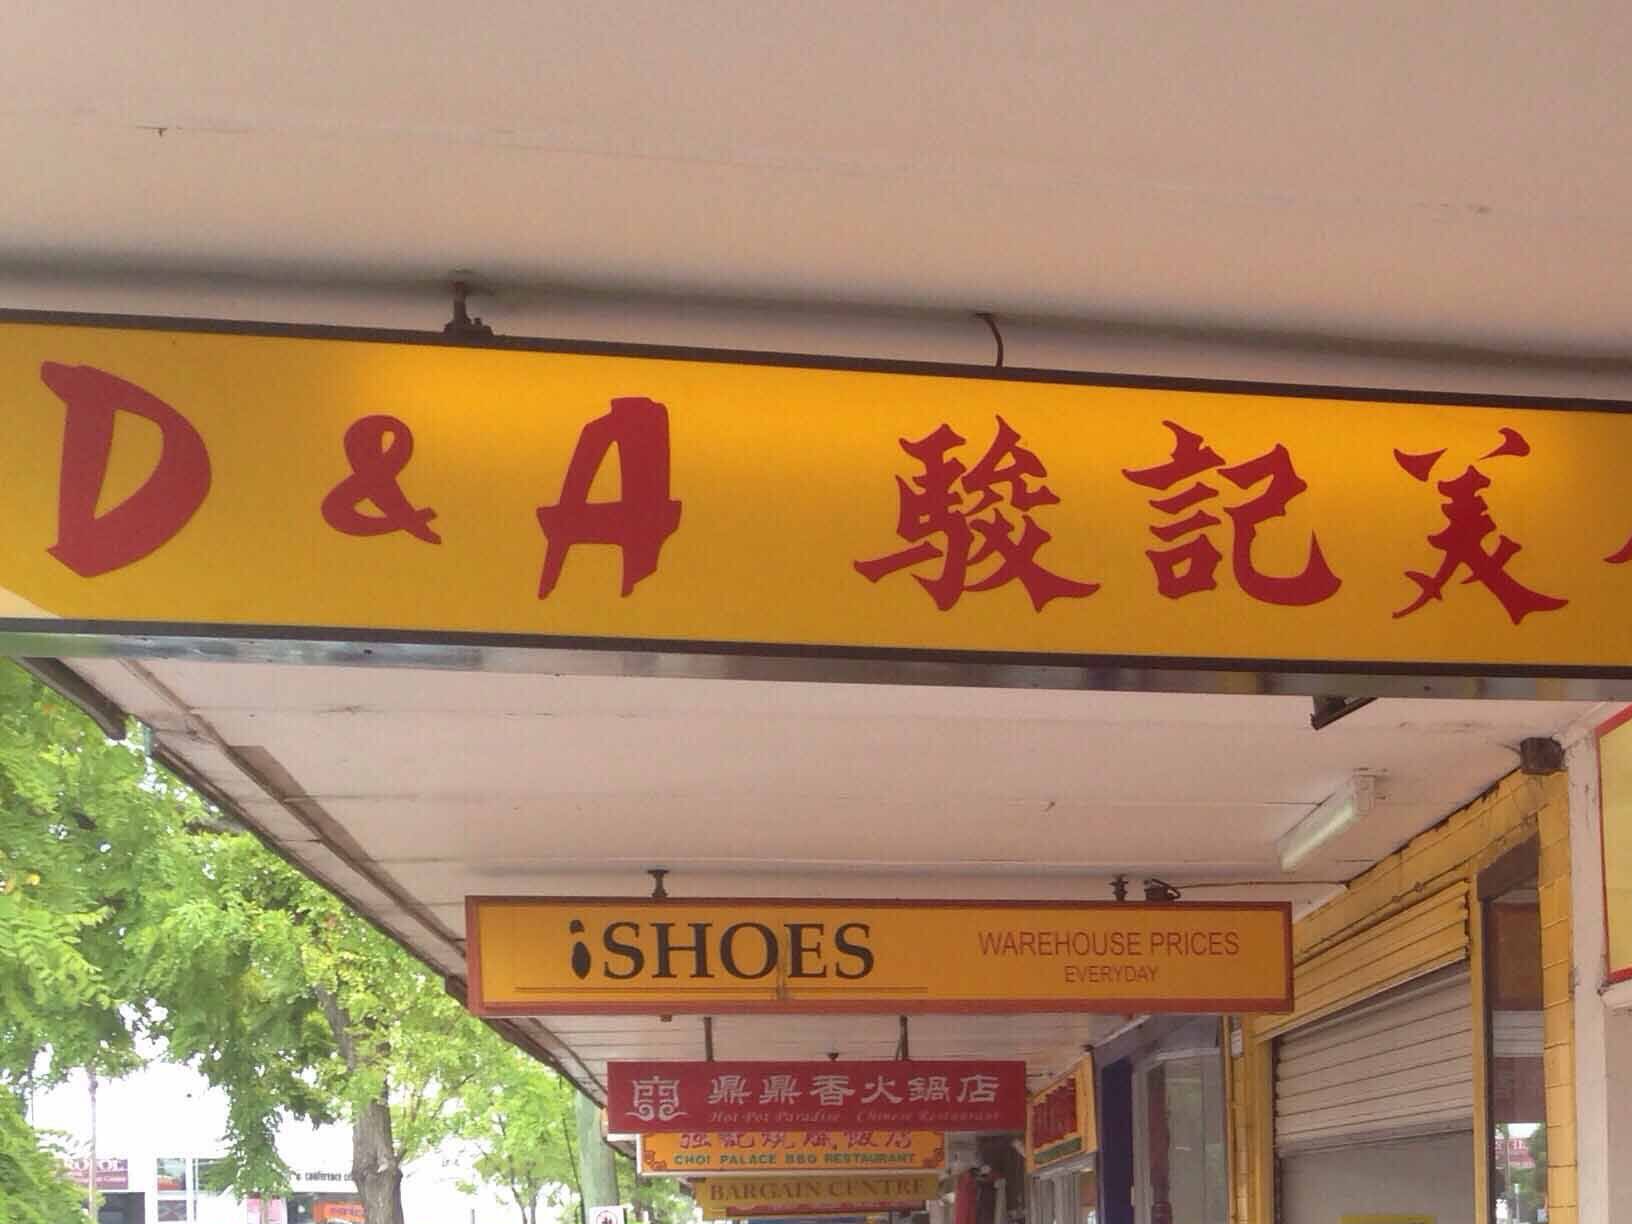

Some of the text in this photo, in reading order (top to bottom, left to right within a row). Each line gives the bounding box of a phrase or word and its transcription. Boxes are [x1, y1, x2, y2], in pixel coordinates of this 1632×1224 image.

[40, 361, 682, 600] D & A
[977, 930, 1240, 957] WAREHOUSE PRICES
[1065, 965, 1159, 983] EVERYDAY
[720, 1153, 776, 1165] PALACE
[709, 1177, 925, 1201] BARGAIN CENTRE
